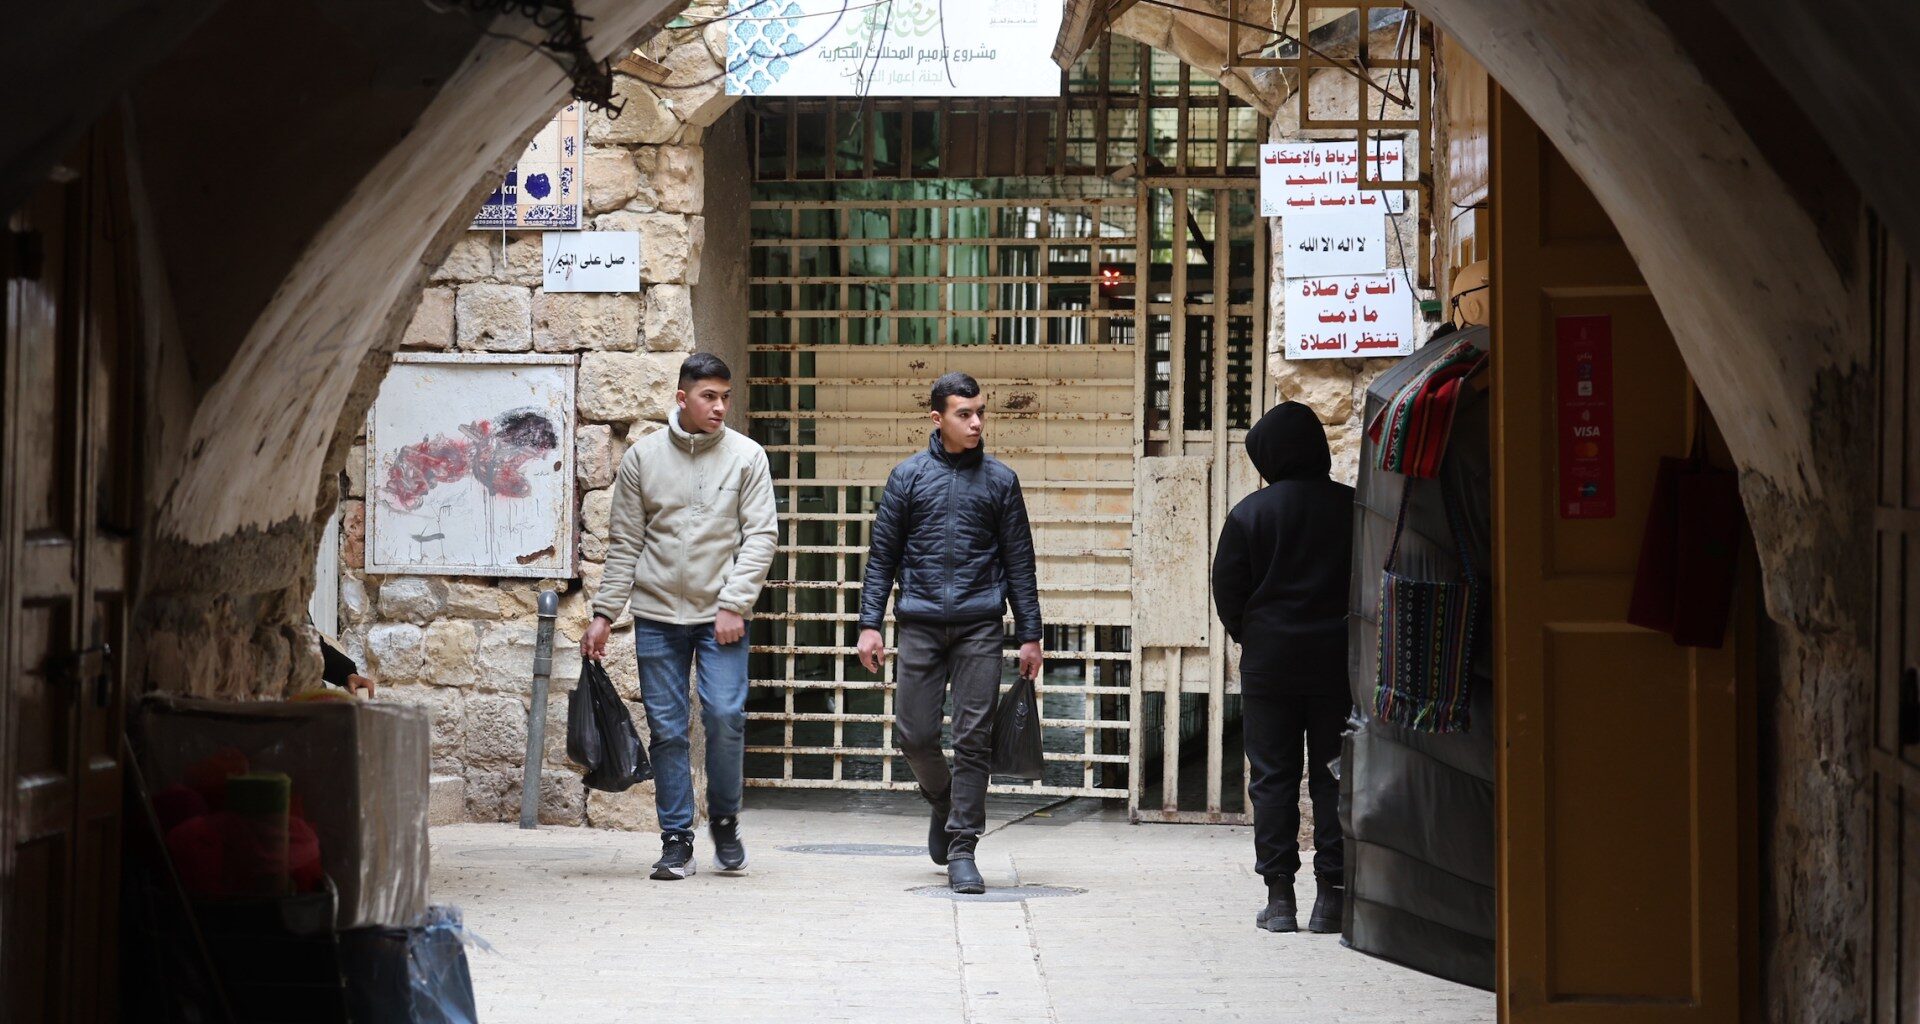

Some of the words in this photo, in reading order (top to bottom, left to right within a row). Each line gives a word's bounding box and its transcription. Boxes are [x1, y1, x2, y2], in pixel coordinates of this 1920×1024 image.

[818, 46, 862, 62] التجارية
[917, 46, 949, 65] ترميم
[953, 43, 996, 62] مشروع
[1325, 149, 1358, 166] لرباط
[1285, 170, 1332, 188] المسجد
[1286, 192, 1315, 209] فيه
[1320, 194, 1355, 206] دمت
[1360, 191, 1376, 205] ما
[1299, 236, 1318, 252] الله
[1337, 236, 1353, 252] اله
[1357, 236, 1366, 252] لا
[580, 252, 601, 269] على
[605, 252, 625, 269] صل
[1302, 280, 1338, 297] صلاة
[1344, 277, 1360, 304] في
[1365, 273, 1395, 294] أنت
[1318, 308, 1357, 323] دمت
[1363, 305, 1378, 322] ما
[1300, 332, 1347, 350] الصلاة
[1352, 332, 1399, 354] تنتظر
[1573, 426, 1600, 437] VISA
